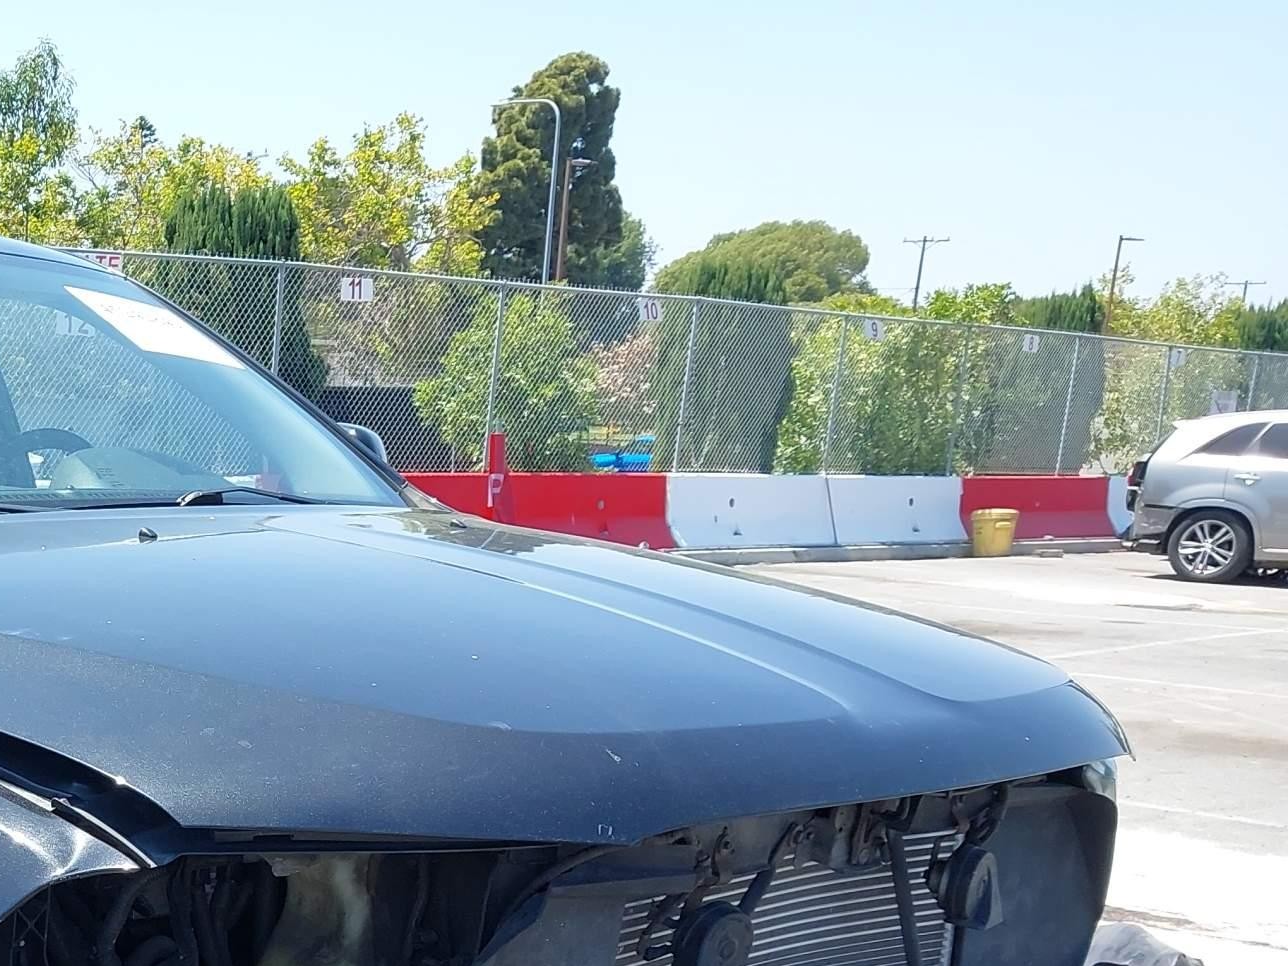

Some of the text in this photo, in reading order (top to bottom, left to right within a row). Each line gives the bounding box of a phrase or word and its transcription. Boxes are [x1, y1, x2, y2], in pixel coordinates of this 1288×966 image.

[348, 278, 362, 300] 11
[643, 301, 659, 320] 10
[871, 321, 878, 337] 9
[1028, 335, 1035, 351] 8
